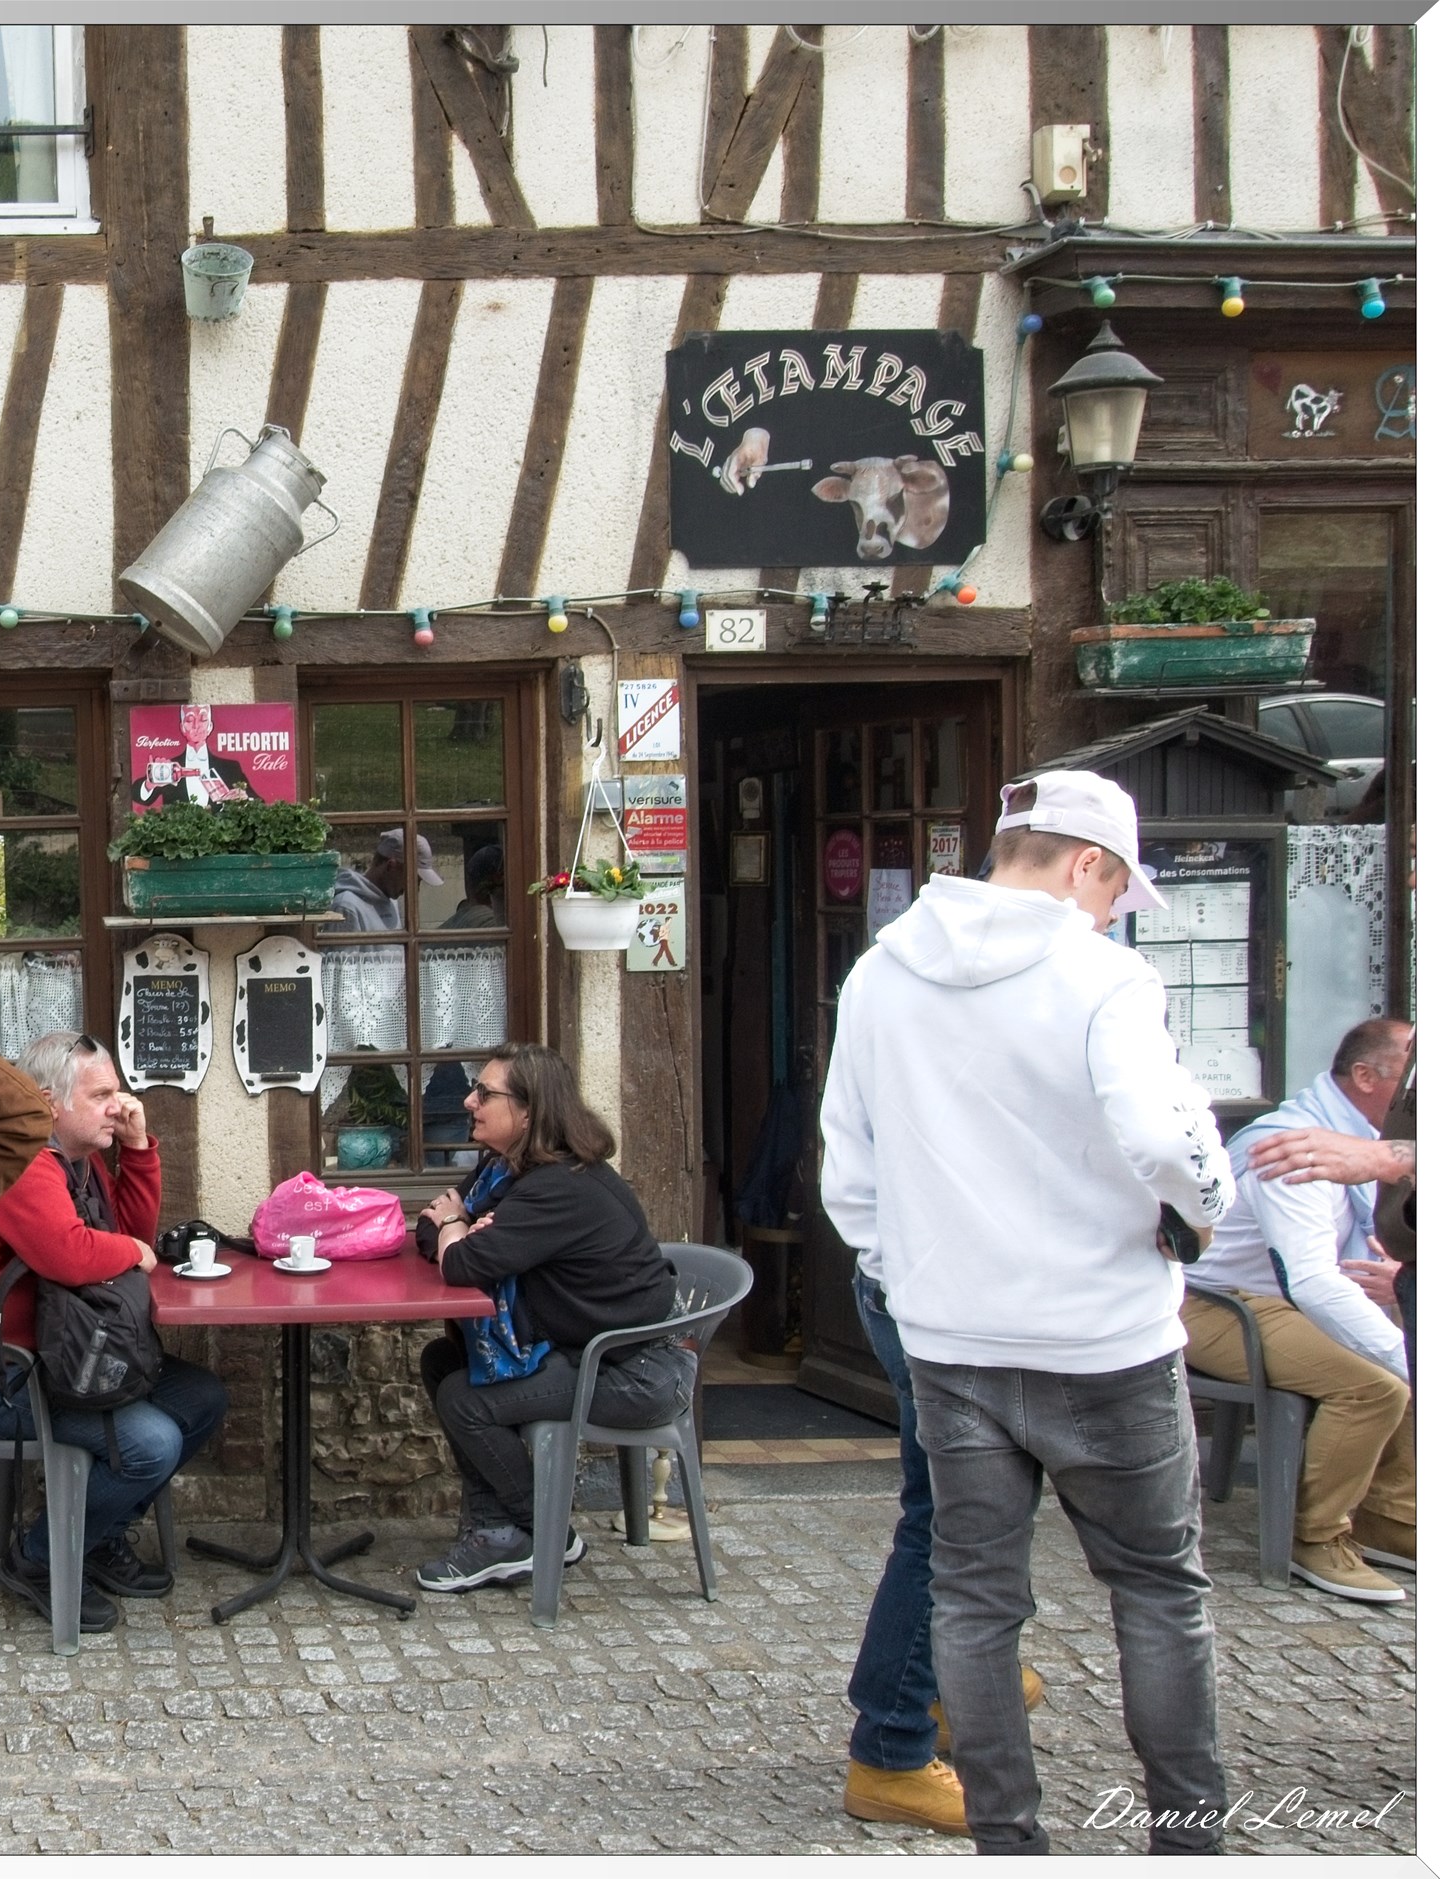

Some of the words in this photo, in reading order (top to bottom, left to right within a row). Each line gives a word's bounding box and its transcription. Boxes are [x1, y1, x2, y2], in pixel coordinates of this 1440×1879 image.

[719, 617, 756, 644] 82
[624, 693, 640, 709] IV
[625, 690, 674, 750] LICENCE
[135, 735, 181, 749] Perfection
[217, 731, 289, 752] PELFORTH
[252, 753, 289, 771] Pale
[628, 795, 682, 805] verisure
[627, 810, 684, 825] Alarme
[932, 837, 958, 853] 2017
[838, 848, 849, 858] LES
[1174, 854, 1215, 863] Heineken
[828, 858, 860, 869] PRODUITS
[1160, 869, 1177, 878] des
[1179, 866, 1251, 877] Consommations
[151, 980, 183, 990] MEMO
[264, 983, 296, 993] MEMO
[1207, 1058, 1219, 1068] CB
[1202, 1073, 1232, 1081] PARTIR
[1214, 1087, 1242, 1096] EUROS
[304, 1197, 332, 1212] est
